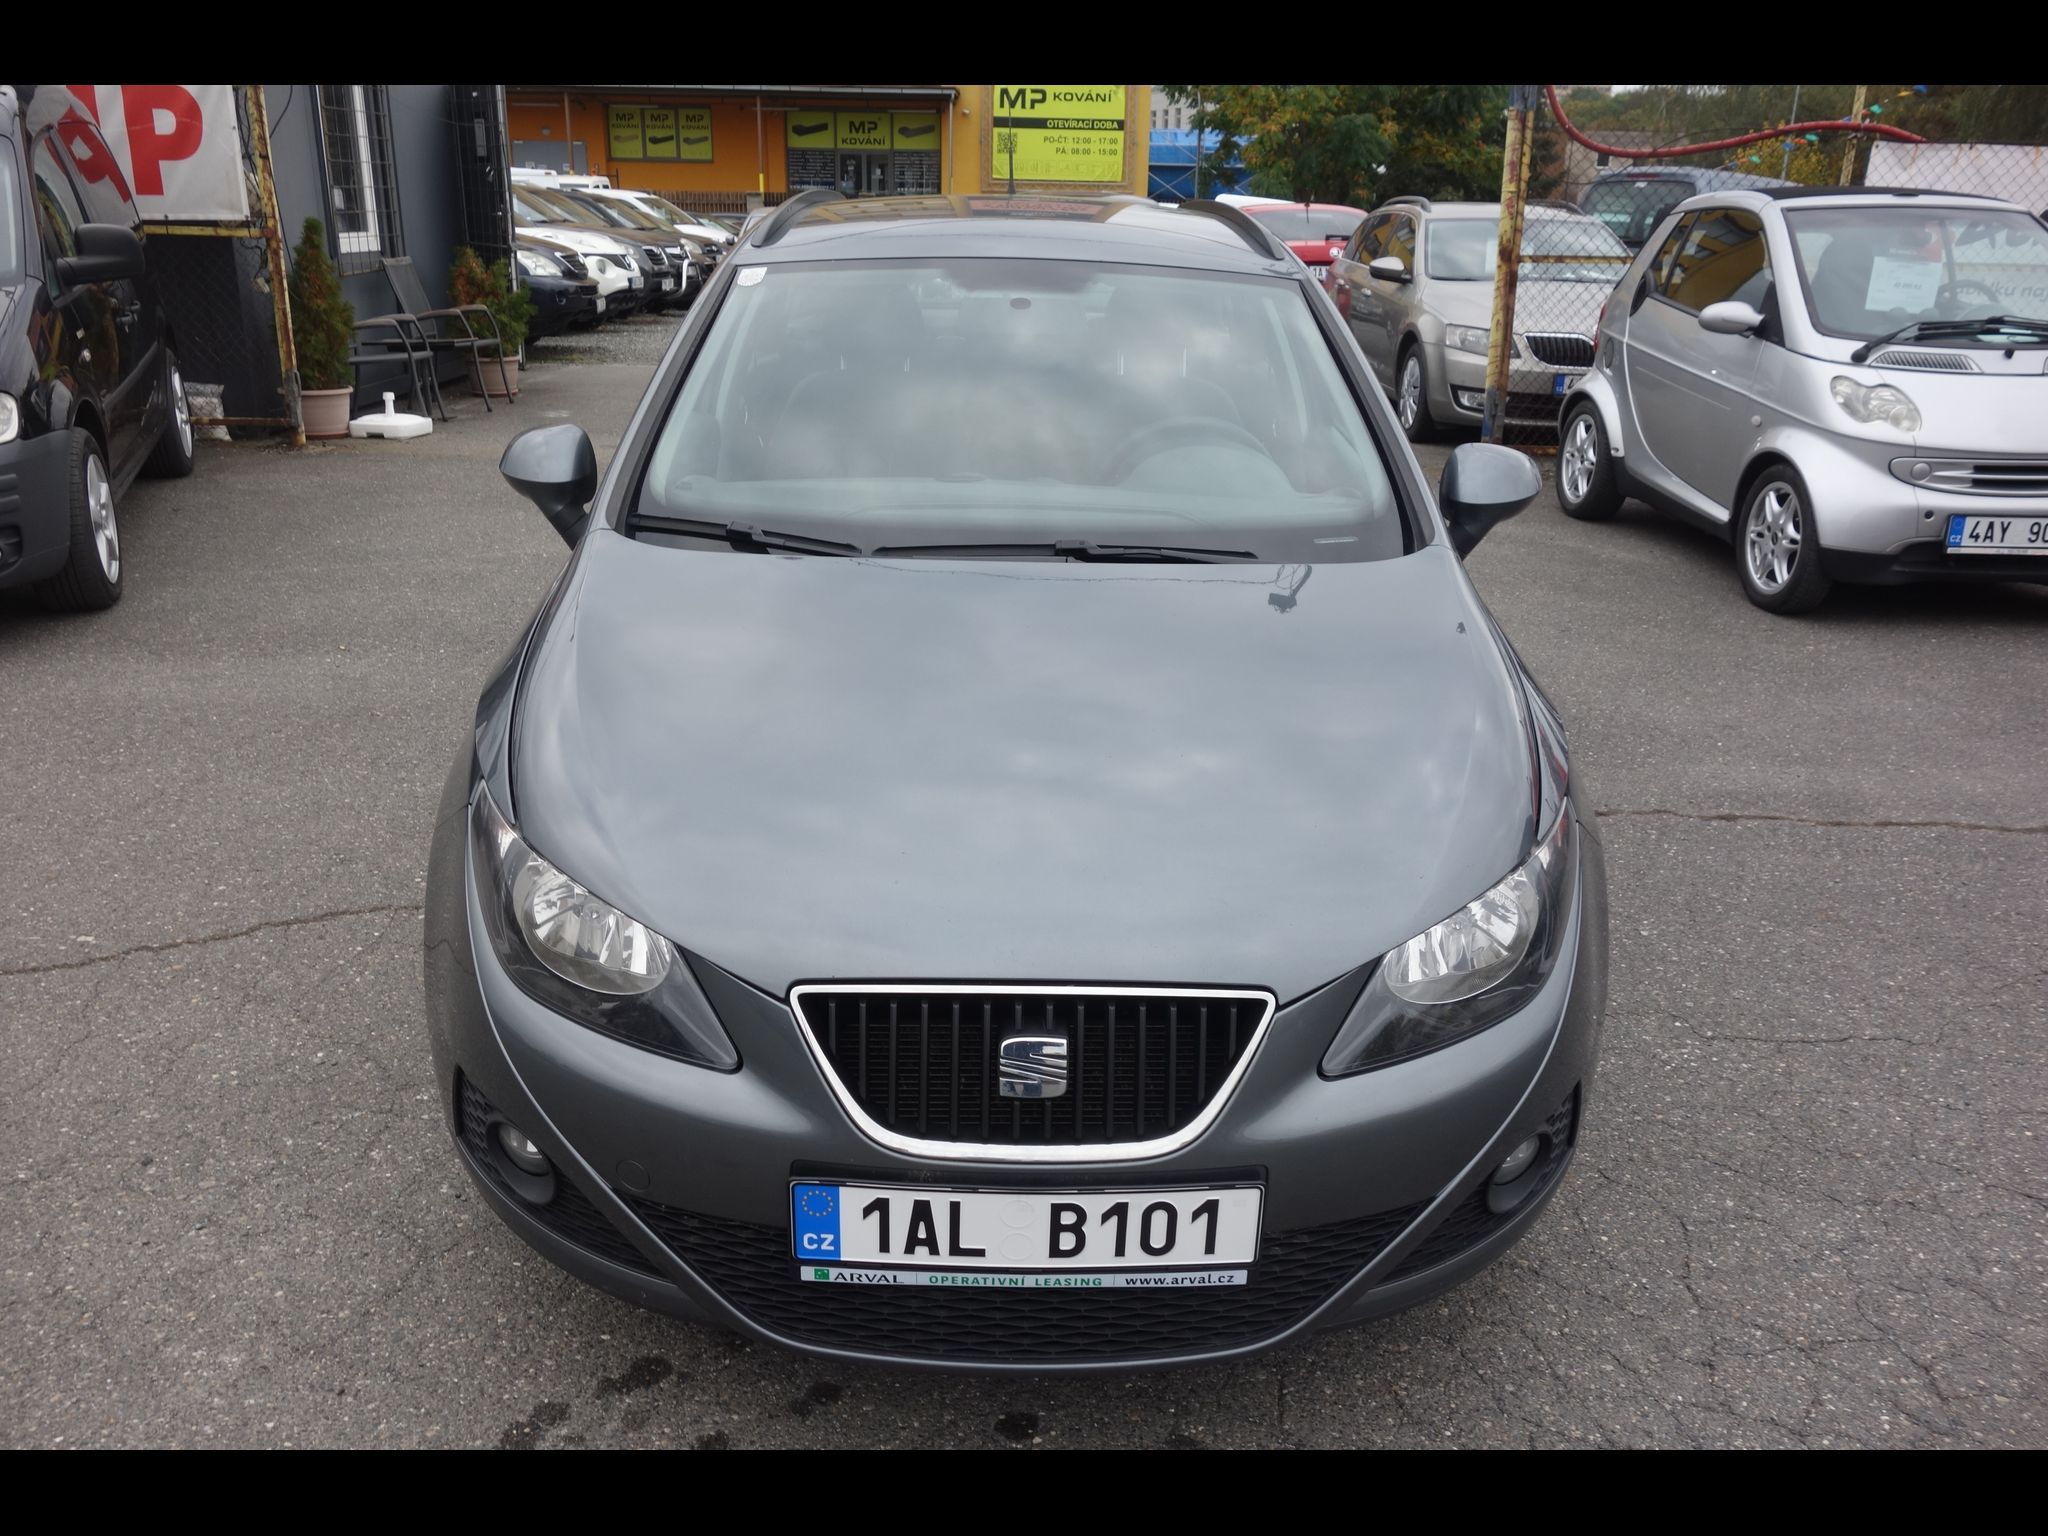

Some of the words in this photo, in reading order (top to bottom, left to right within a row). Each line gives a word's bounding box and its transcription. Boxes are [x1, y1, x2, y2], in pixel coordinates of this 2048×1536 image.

[999, 87, 1047, 109] MP
[1053, 90, 1112, 103] KOVÁNÍ
[615, 113, 634, 121] MP
[685, 114, 705, 122] MP
[849, 120, 878, 134] MP
[1046, 119, 1093, 129] OTEVÍRACÍ
[1094, 121, 1119, 130] DOBA
[841, 136, 886, 146] KOVÁNÍ
[1072, 137, 1092, 145] 12:00
[1968, 521, 2012, 543] 4AY
[803, 1232, 835, 1251] CZ
[862, 1197, 986, 1257] 1AL
[1048, 1199, 1220, 1258] B101
[834, 1272, 905, 1284] ARVAL
[928, 1275, 1026, 1287] OPERATIVNÍ
[1035, 1277, 1102, 1287] LEASING
[1125, 1274, 1235, 1286] www.arval.cz
